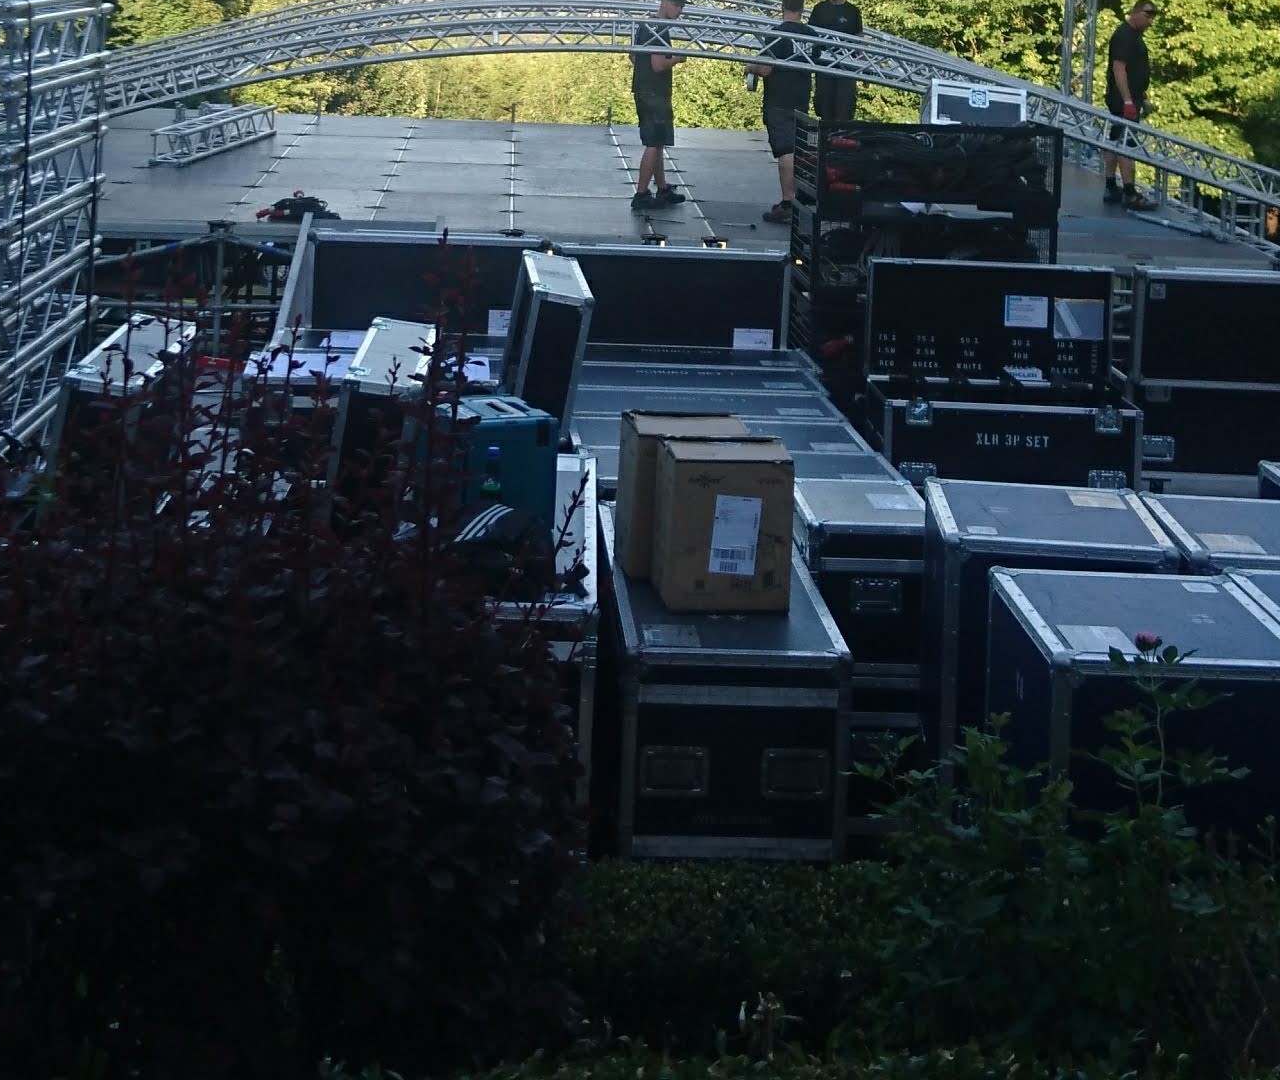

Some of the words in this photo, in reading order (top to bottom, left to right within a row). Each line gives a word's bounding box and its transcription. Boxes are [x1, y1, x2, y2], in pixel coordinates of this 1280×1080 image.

[956, 362, 982, 370] WHITE
[976, 432, 999, 446] XLR
[1005, 433, 1020, 446] 3P
[1025, 435, 1050, 448] SET
